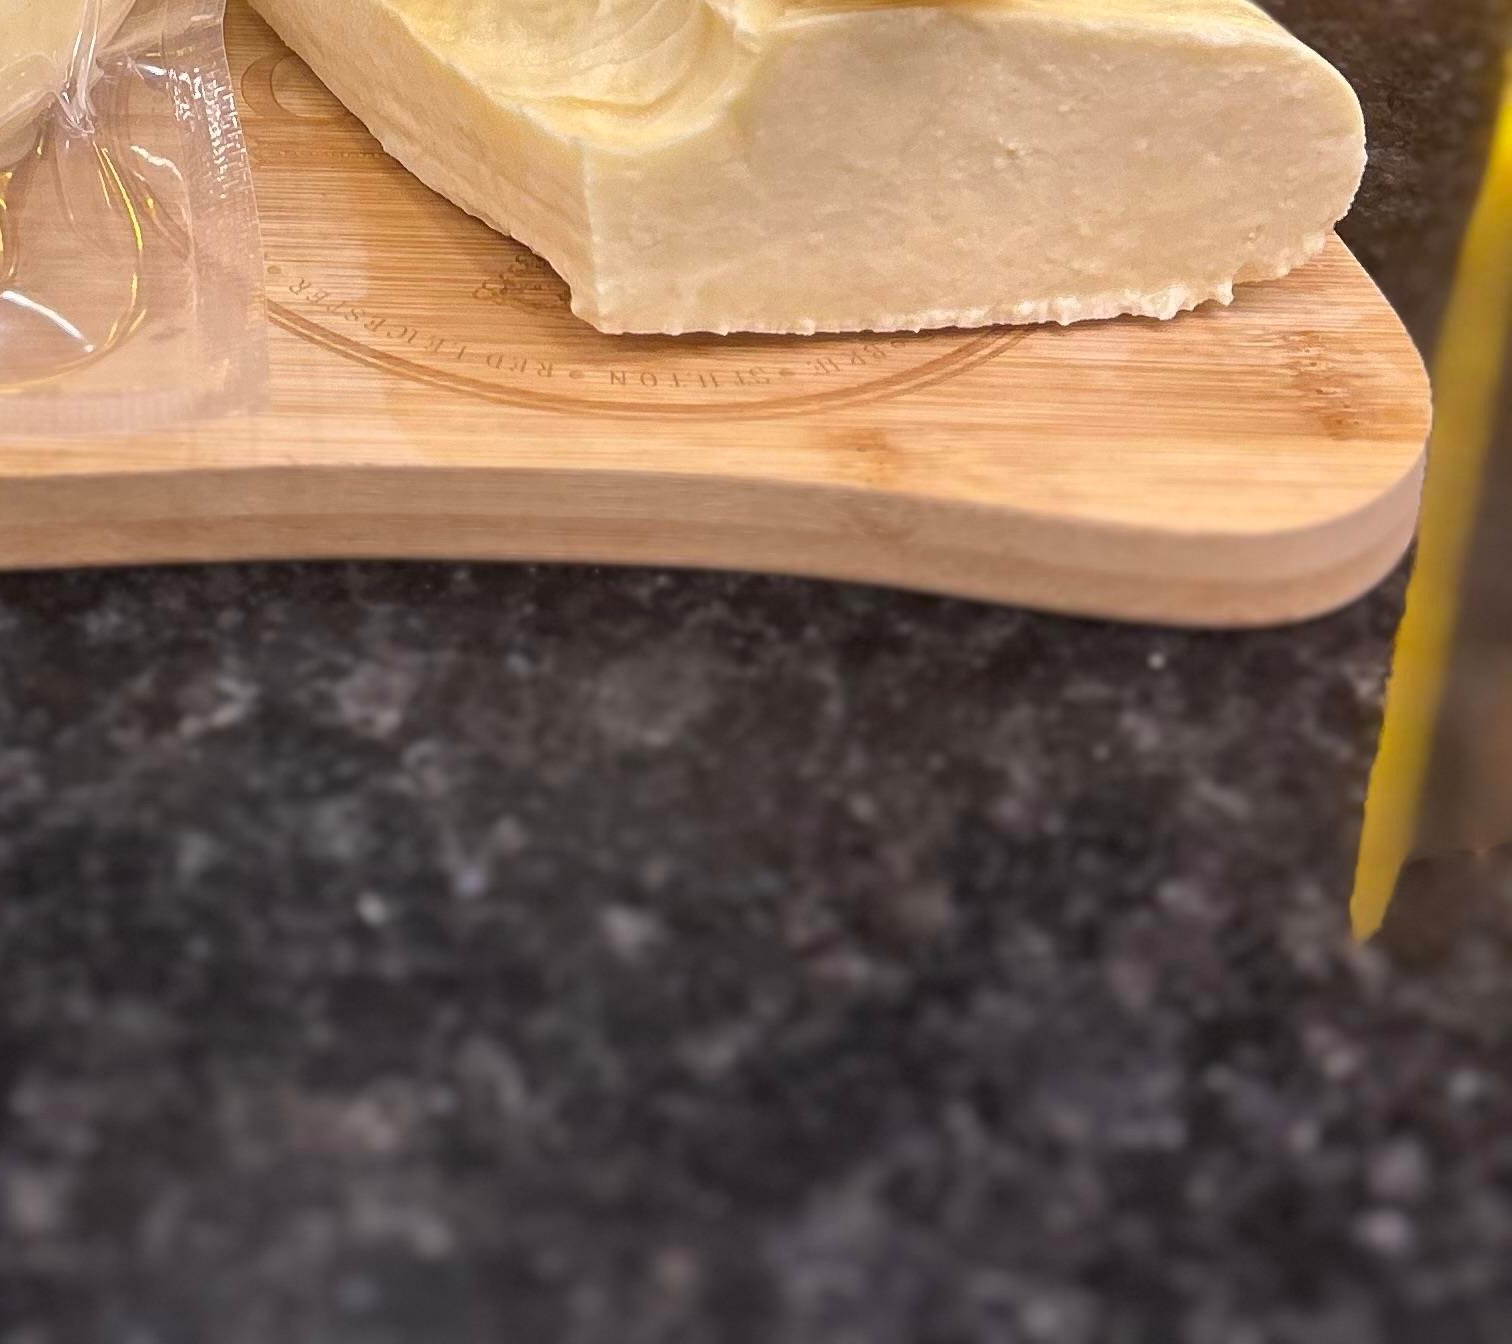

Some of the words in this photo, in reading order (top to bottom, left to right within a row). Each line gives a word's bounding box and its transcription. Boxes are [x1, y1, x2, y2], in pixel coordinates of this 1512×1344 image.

[288, 278, 468, 361] LEICESTER
[486, 353, 555, 379] RED
[609, 366, 772, 389] STILTON
